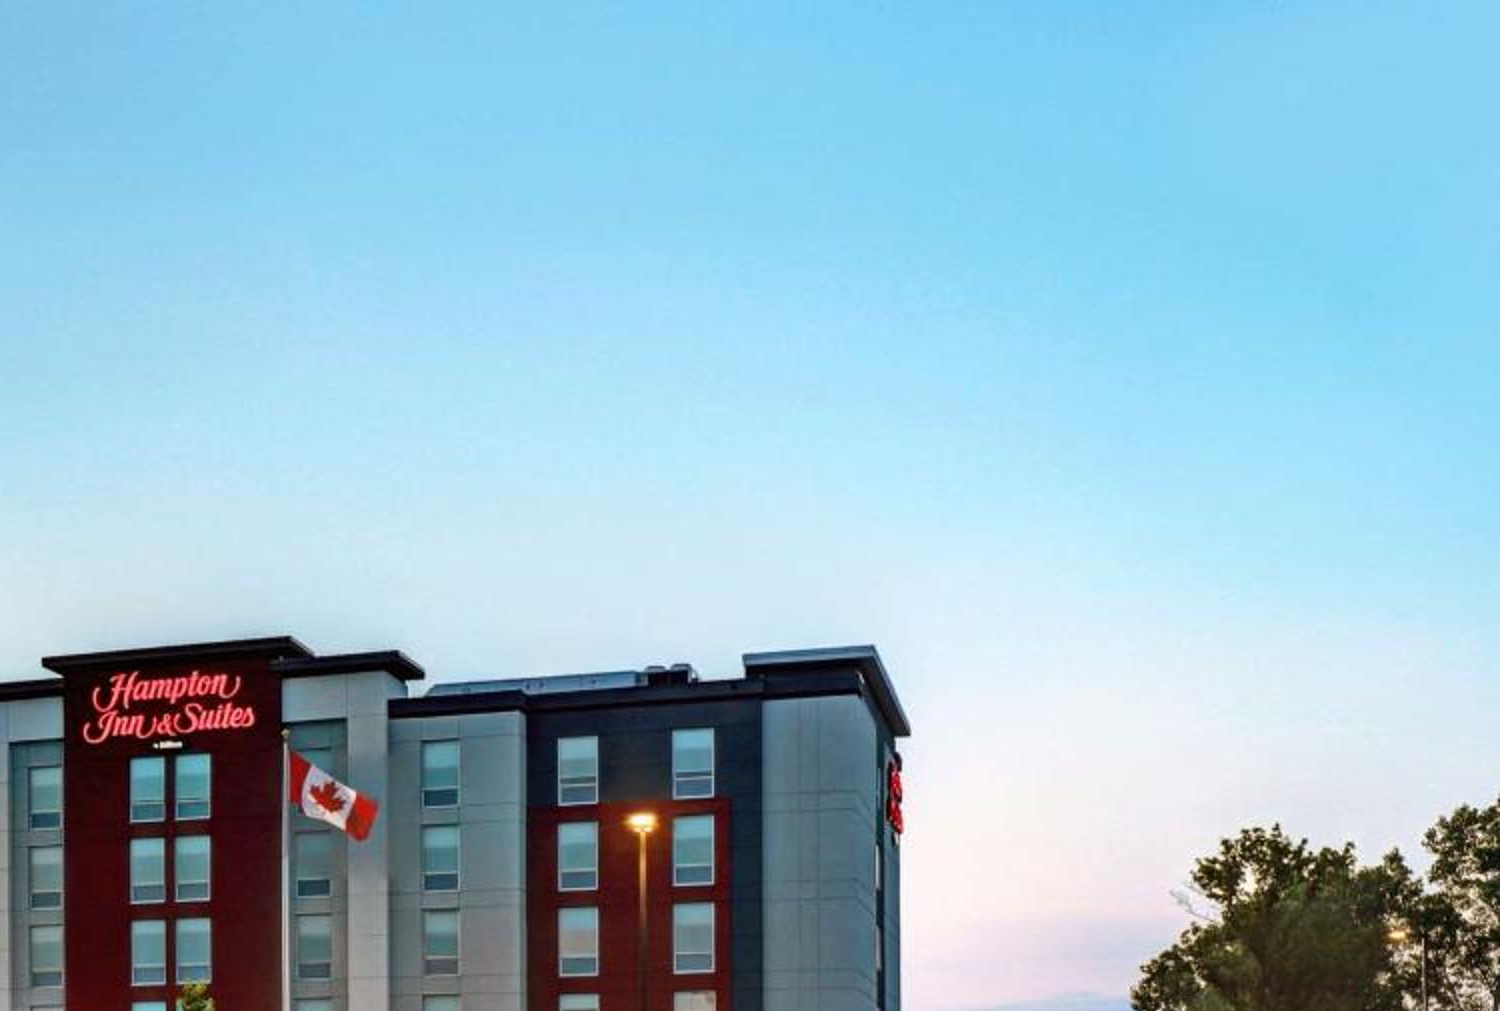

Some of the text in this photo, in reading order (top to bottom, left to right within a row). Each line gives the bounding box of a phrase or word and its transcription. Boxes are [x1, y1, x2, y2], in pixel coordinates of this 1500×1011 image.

[92, 670, 241, 713] Hampton
[83, 702, 255, 744] Inn & Suites
